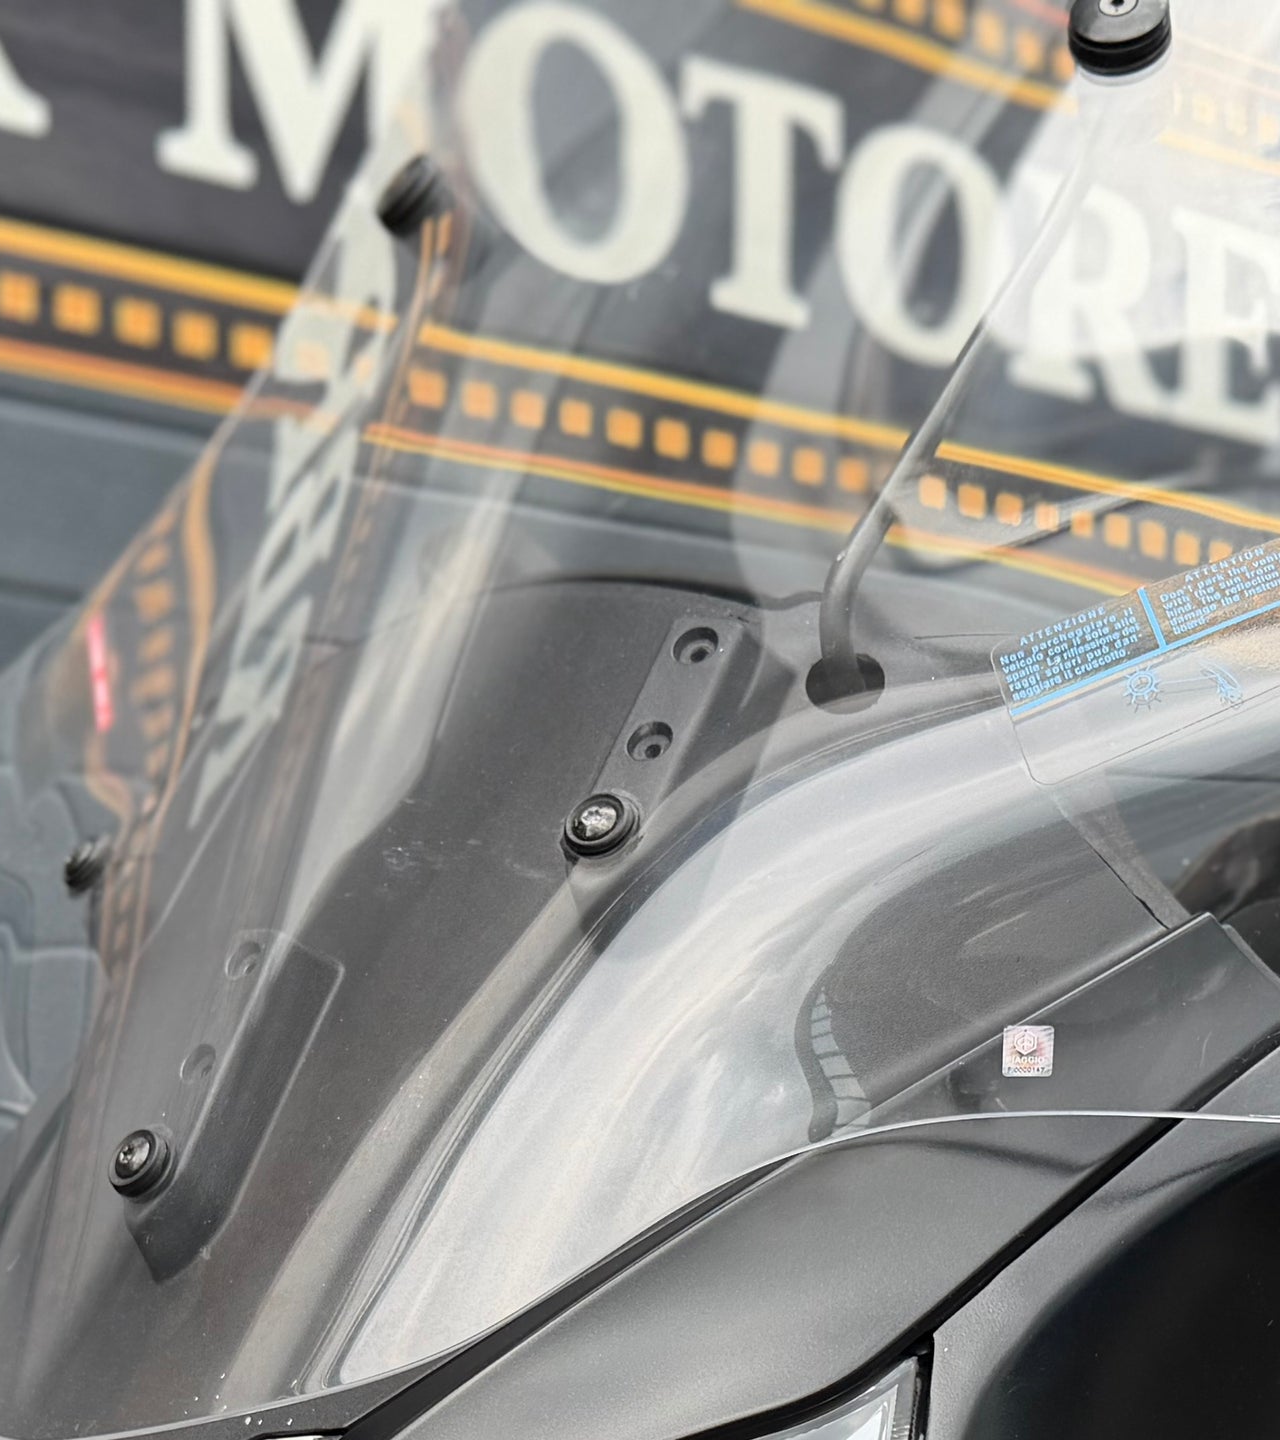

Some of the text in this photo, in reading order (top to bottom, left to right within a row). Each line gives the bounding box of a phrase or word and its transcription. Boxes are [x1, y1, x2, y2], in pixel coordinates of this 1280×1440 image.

[1185, 548, 1264, 582] ATTENTION
[1198, 575, 1224, 589] park
[1228, 566, 1248, 576] the
[1163, 595, 1190, 610] with
[1194, 587, 1214, 598] the
[1219, 577, 1241, 589] sun
[1246, 565, 1275, 579] from
[1200, 593, 1221, 604] The
[1225, 571, 1279, 595] reflection
[1020, 607, 1105, 646] ATTENZIONE
[1170, 603, 1216, 626] damage
[1221, 594, 1240, 607] the
[1000, 608, 1133, 665] Non parcheggiare il
[1002, 617, 1136, 674] veicolo con il sole alle
[1046, 655, 1060, 666] La
[1122, 624, 1140, 636] dei
[1009, 672, 1040, 692] raggi
[1045, 659, 1081, 677] solari
[1064, 670, 1073, 679] il
